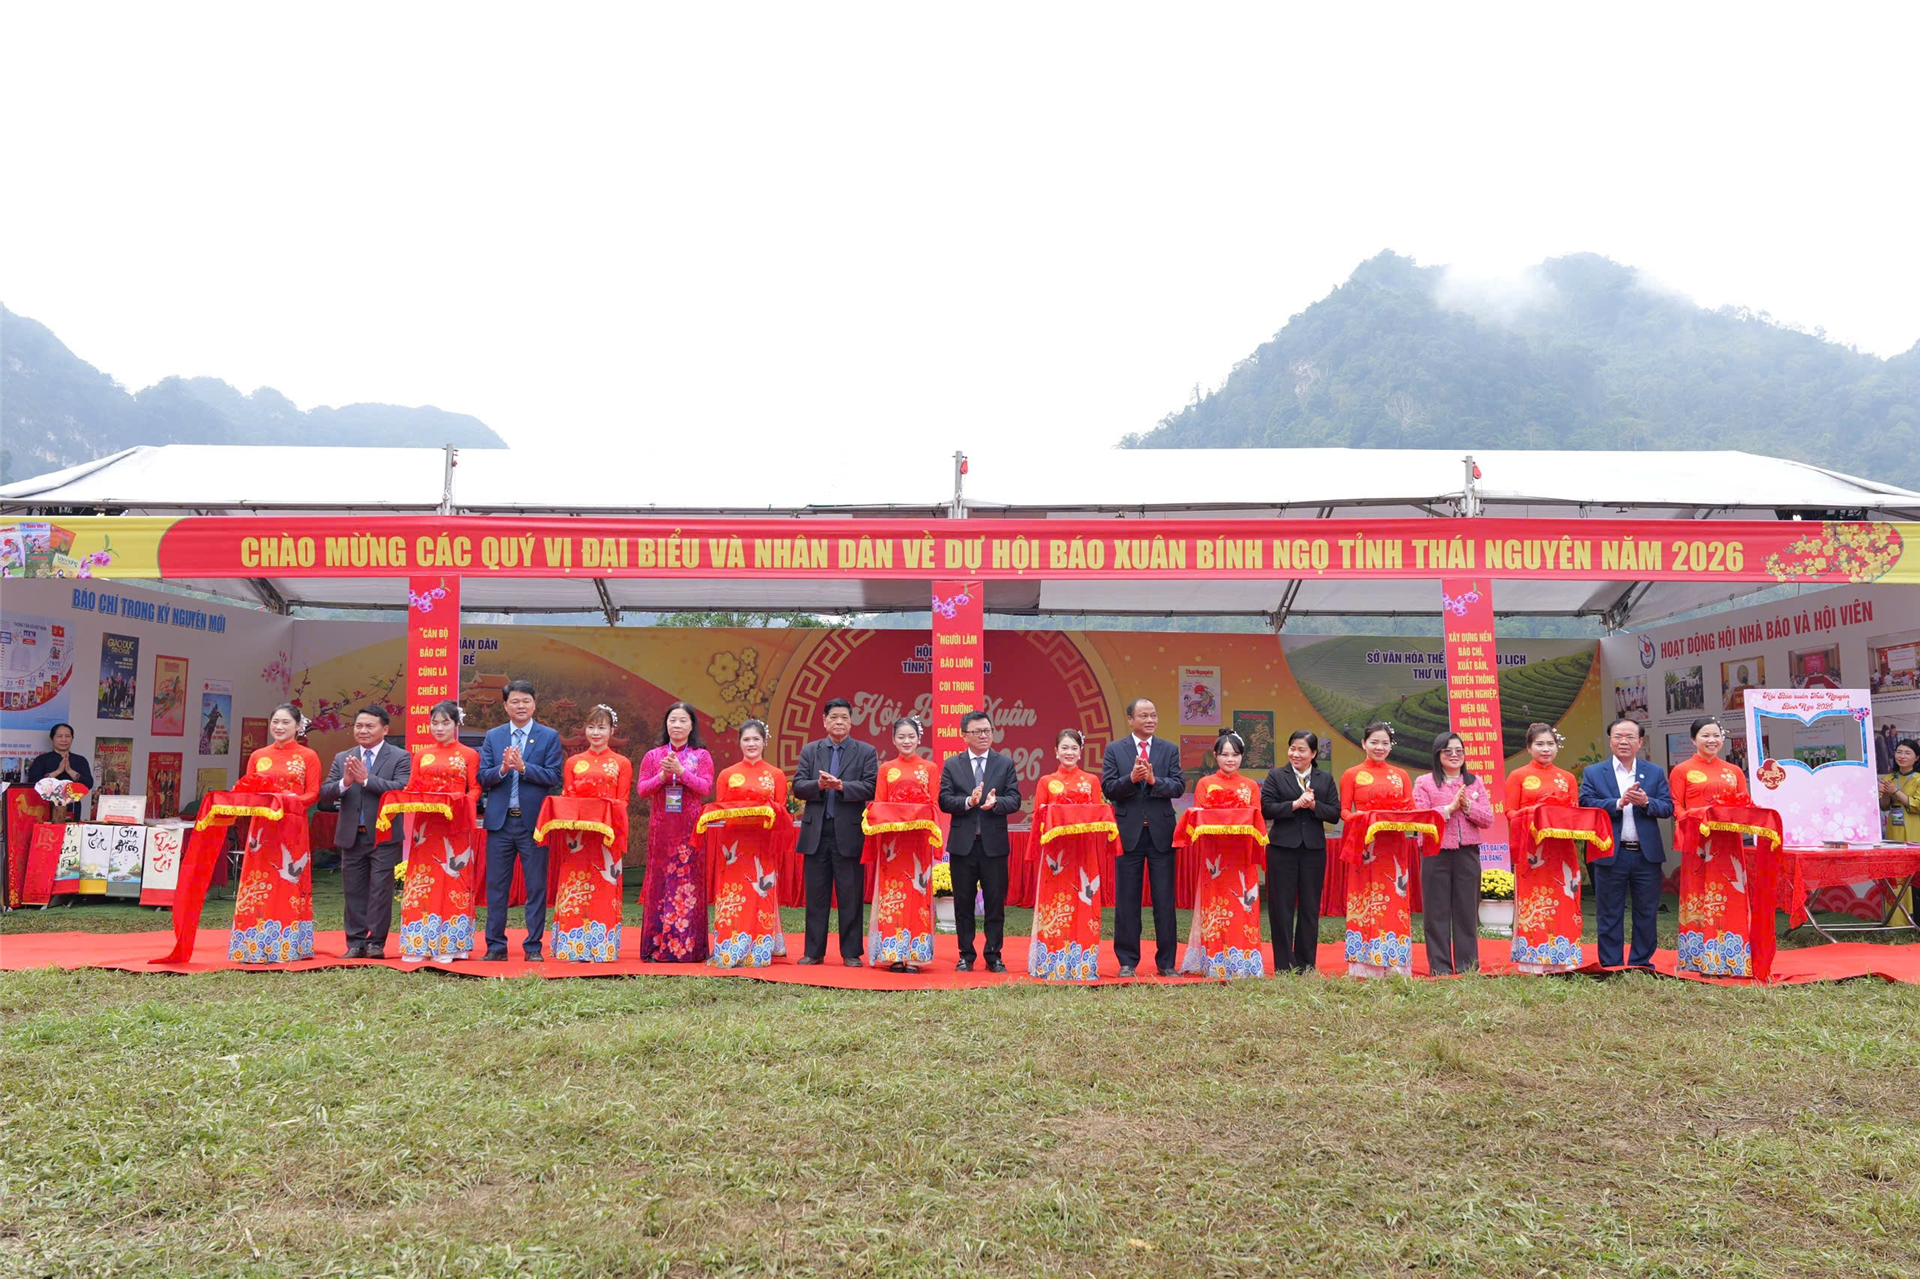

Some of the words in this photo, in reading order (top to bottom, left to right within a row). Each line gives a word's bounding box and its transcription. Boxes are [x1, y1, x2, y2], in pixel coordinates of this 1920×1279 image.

[241, 532, 315, 567] CHÀO
[325, 532, 406, 567] MỪNG
[416, 532, 472, 567] CÁC
[481, 532, 535, 570] QUÝ
[544, 537, 572, 573] VỊ
[581, 537, 628, 573] ĐẠI
[638, 527, 700, 568] BIỂU
[709, 534, 746, 568] VÀ
[754, 534, 828, 568] NHÂN
[838, 534, 893, 568] DÂN
[902, 530, 935, 569] VỀ
[945, 535, 985, 574] DỰ
[992, 534, 1040, 574] HỘI
[1050, 534, 1105, 569] BÁO
[1113, 534, 1186, 569] XUÂN
[1196, 534, 1263, 569] BÍNH
[1273, 539, 1329, 574] NGỌ
[1338, 532, 1403, 569] TỈNH
[1412, 534, 1475, 569] THÁI
[1485, 535, 1591, 570] NGUYÊN
[1601, 535, 1662, 571] NĂM
[1671, 541, 1744, 571] 2026
[72, 588, 96, 611] BÁO
[98, 593, 119, 615] CHÍ
[121, 598, 155, 622] TRONG
[172, 609, 206, 630] NGUYÊN
[208, 614, 226, 633] MỚI
[439, 627, 448, 640] BỘ
[1661, 639, 1685, 660] HOẠT
[1687, 632, 1715, 658] ĐỘNG
[1718, 625, 1736, 651] HỘI
[1739, 619, 1763, 645] NHÀ
[1766, 615, 1790, 640] BÁO
[1793, 610, 1811, 634] VÀ
[1814, 605, 1836, 634] HỘI
[1840, 599, 1873, 626] VIÊN
[478, 637, 498, 650] DÂN
[962, 633, 977, 645] LÀM
[1448, 631, 1460, 642] XÂY
[1461, 632, 1478, 644] DỰNG
[420, 647, 433, 658] BÁO
[435, 647, 447, 657] CHÍ
[1367, 649, 1380, 663] SỞ
[1382, 650, 1402, 664] VĂN
[1404, 651, 1424, 664] HÓA
[1458, 645, 1471, 656] BÁO
[903, 658, 925, 673] TỈNH
[940, 657, 954, 668] BÁO
[955, 656, 973, 668] LUÔN
[1505, 655, 1526, 667] LỊCH
[418, 666, 437, 677] CŨNG
[439, 666, 447, 676] LÀ
[1413, 668, 1432, 679] THƯ
[1475, 673, 1496, 685] THÔNG
[418, 684, 438, 695] CHIẾN
[440, 684, 447, 695] SĨ
[939, 681, 951, 692] COI
[952, 681, 975, 693] TRỌNG
[410, 705, 429, 715] CÁCH
[940, 704, 949, 714] TU
[851, 691, 901, 736] Hội
[982, 694, 1037, 743] Xuân
[1475, 731, 1484, 741] VAI
[1484, 760, 1495, 770] TIN
